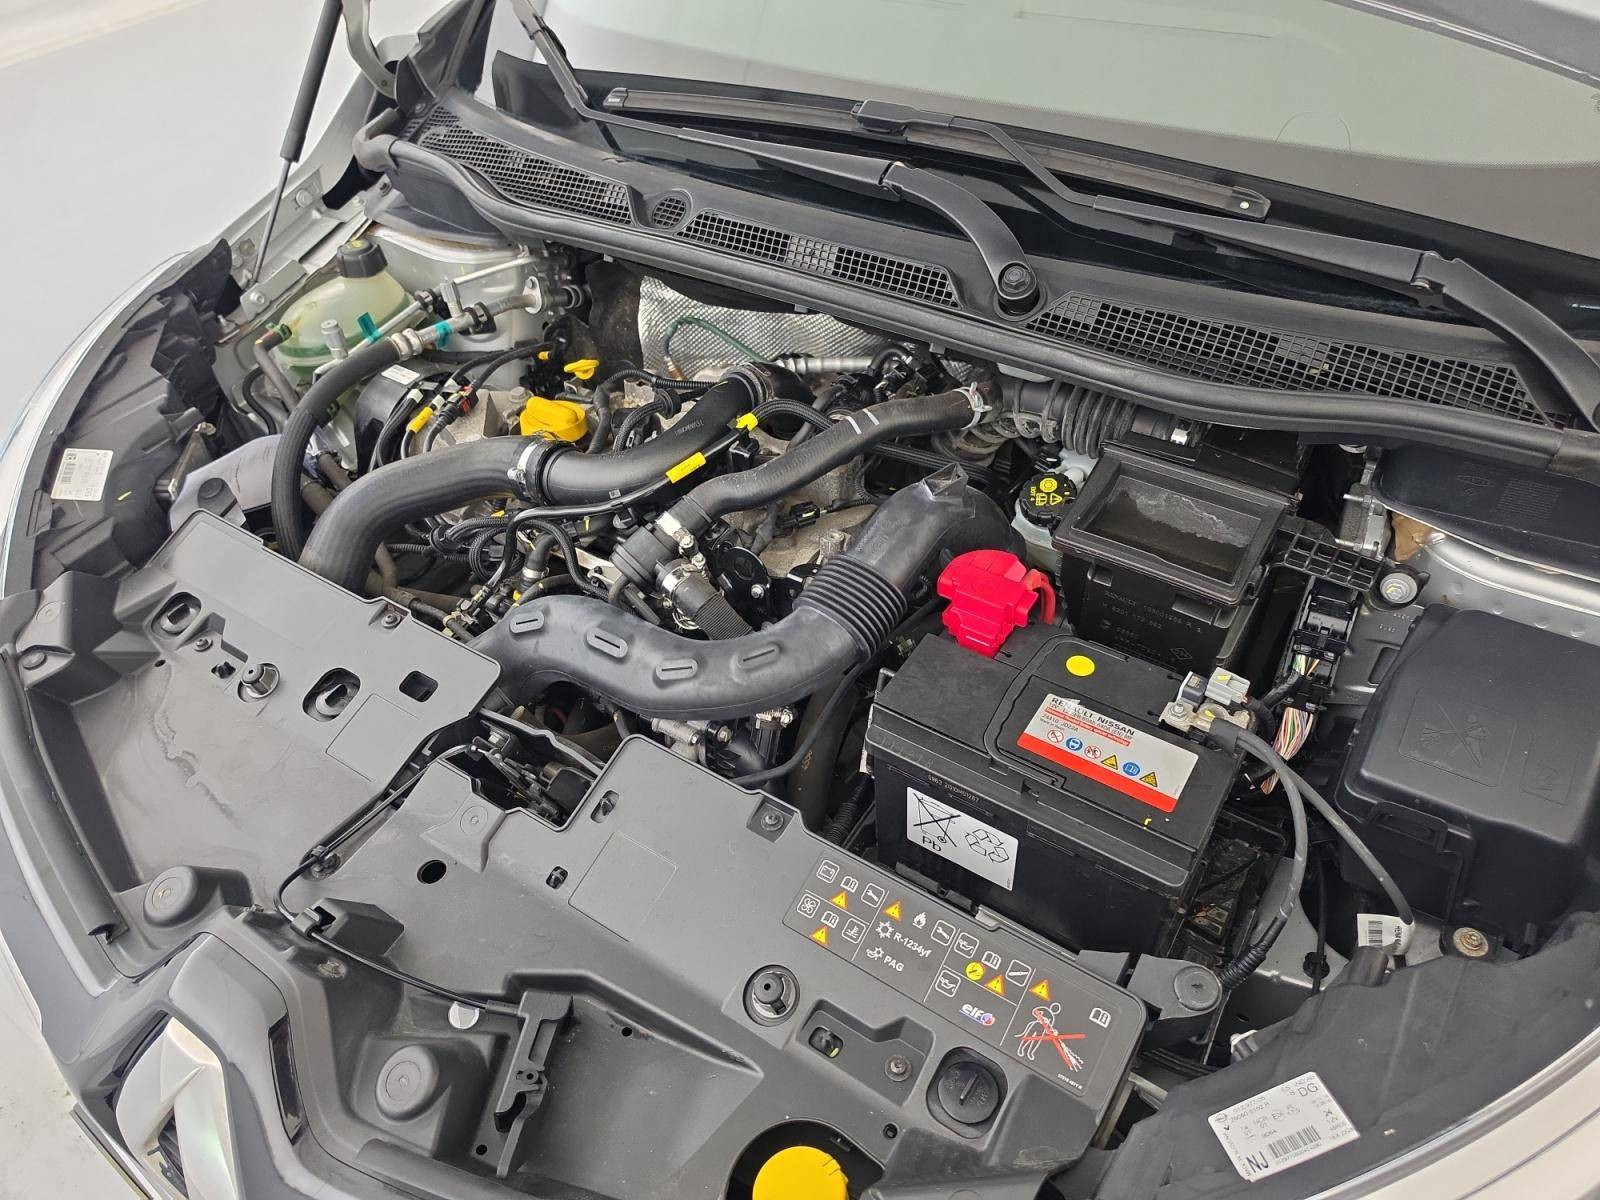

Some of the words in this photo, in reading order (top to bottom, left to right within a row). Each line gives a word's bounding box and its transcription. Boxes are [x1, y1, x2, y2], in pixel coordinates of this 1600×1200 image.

[1097, 716, 1136, 736] NISSAN
[922, 836, 942, 852] Pb
[893, 932, 932, 958] R-1234yf
[883, 956, 905, 972] PAG
[961, 1003, 984, 1019] elf
[1297, 1082, 1319, 1097] DG
[1245, 1150, 1269, 1174] NJ
